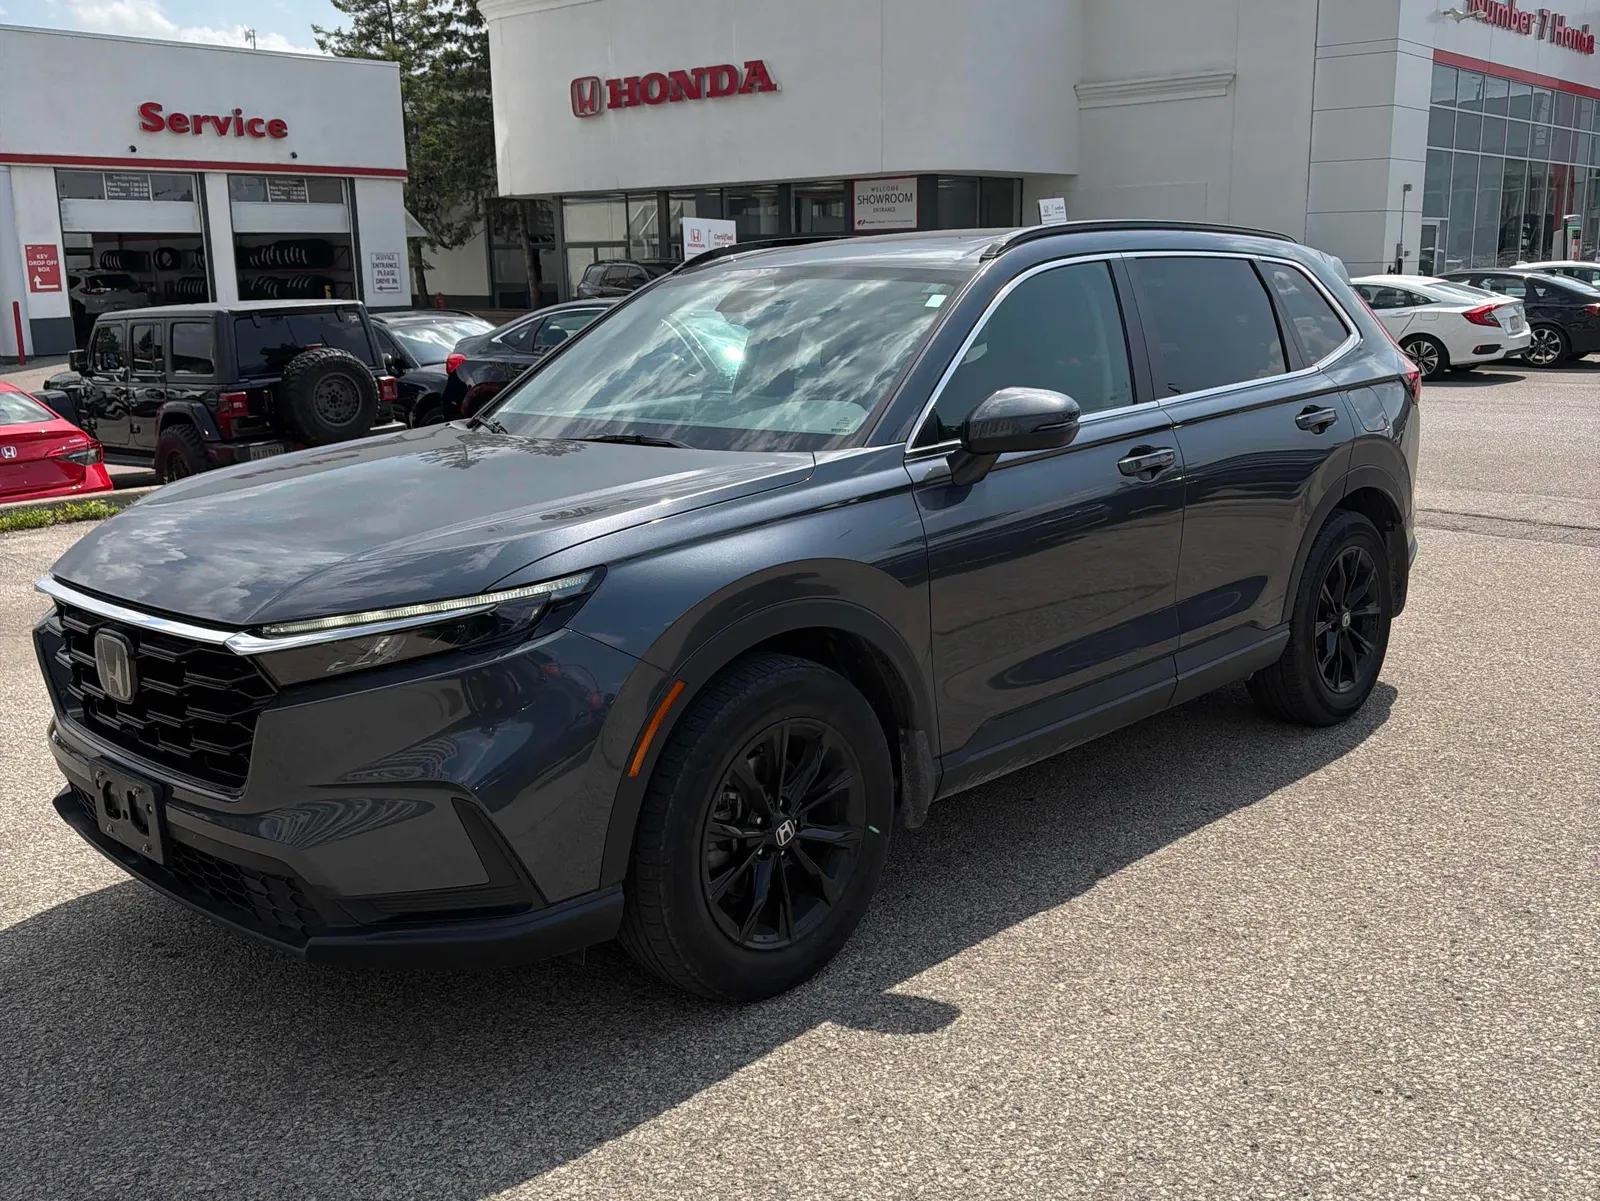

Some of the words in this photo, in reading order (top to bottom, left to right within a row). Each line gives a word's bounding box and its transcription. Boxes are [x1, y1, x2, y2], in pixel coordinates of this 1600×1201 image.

[1539, 9, 1550, 40] 7
[1551, 13, 1595, 54] Honda
[605, 60, 777, 109] HONDA
[139, 101, 288, 139] Service
[857, 192, 913, 205] SHOWROOM
[714, 233, 734, 241] Certified
